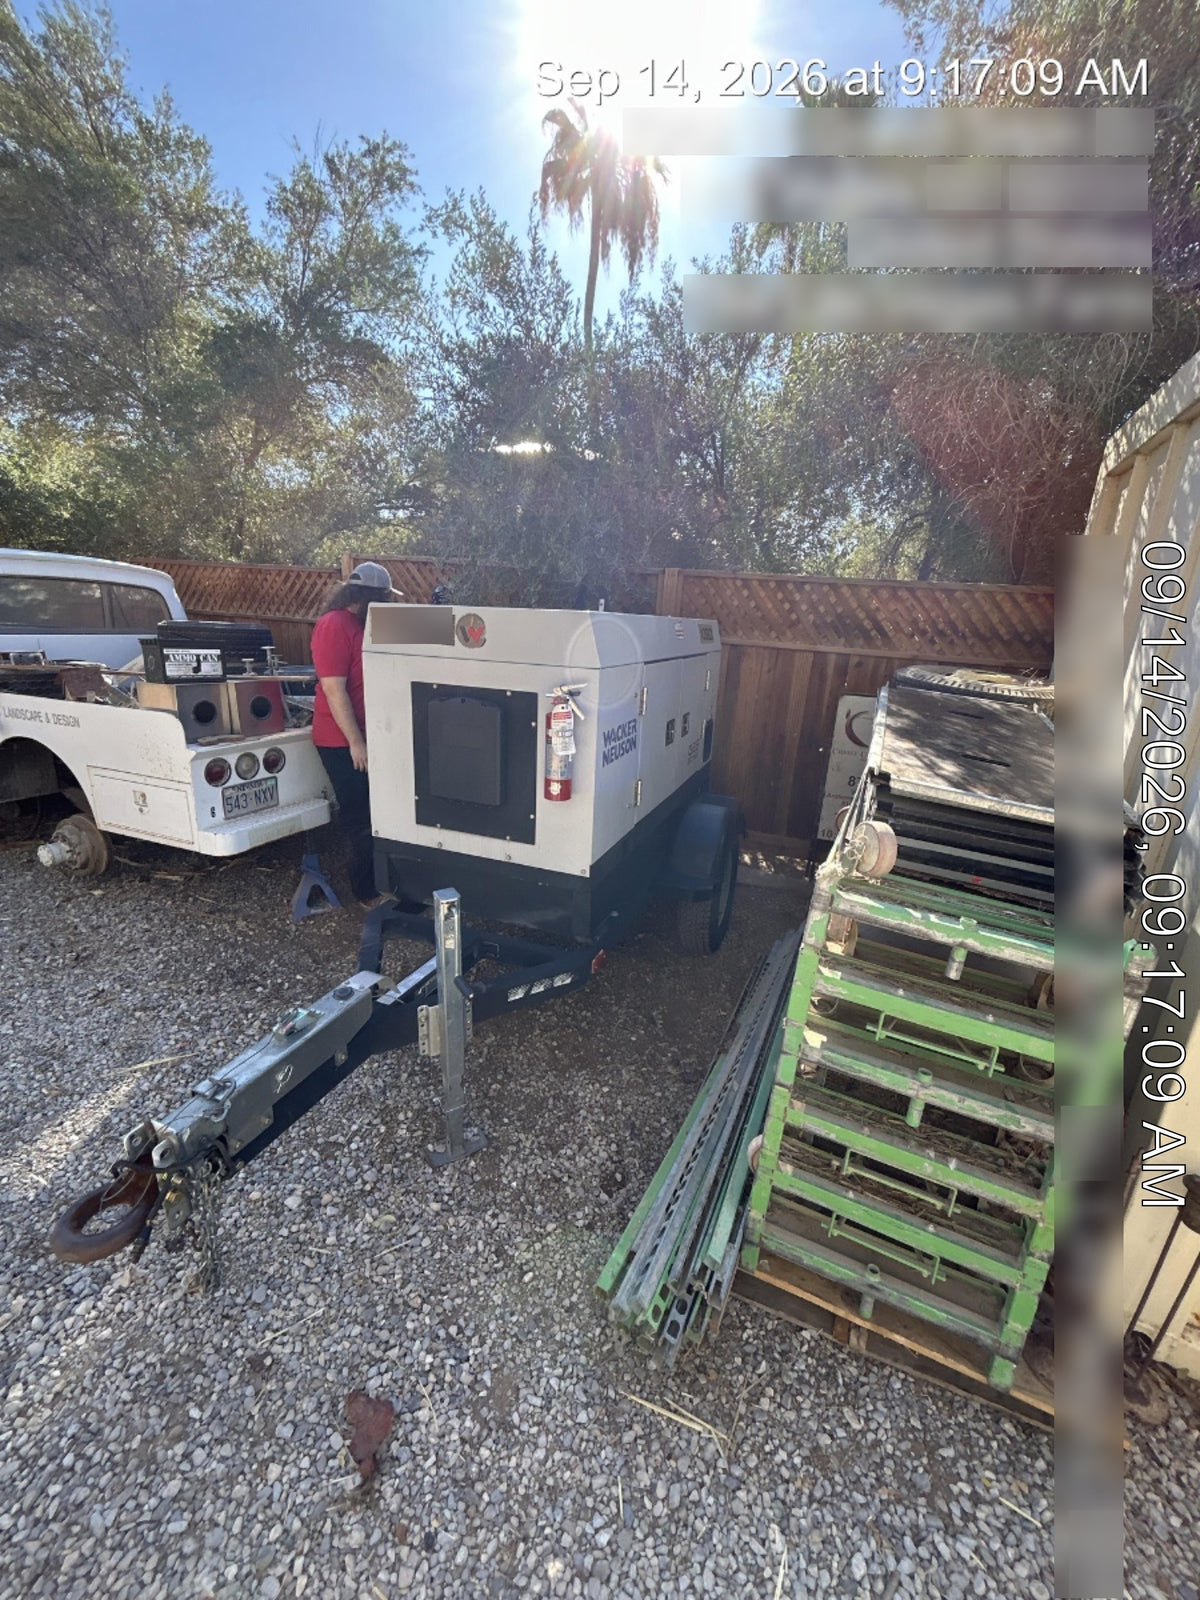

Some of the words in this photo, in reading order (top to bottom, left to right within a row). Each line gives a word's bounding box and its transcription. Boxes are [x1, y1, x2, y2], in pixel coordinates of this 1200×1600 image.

[168, 653, 197, 663] AMMO
[199, 653, 219, 663] CAN
[2, 705, 44, 723] LANDSCAPE
[51, 712, 80, 729] DESIGN
[602, 718, 637, 748] WACKER
[602, 734, 637, 768] NEUSON
